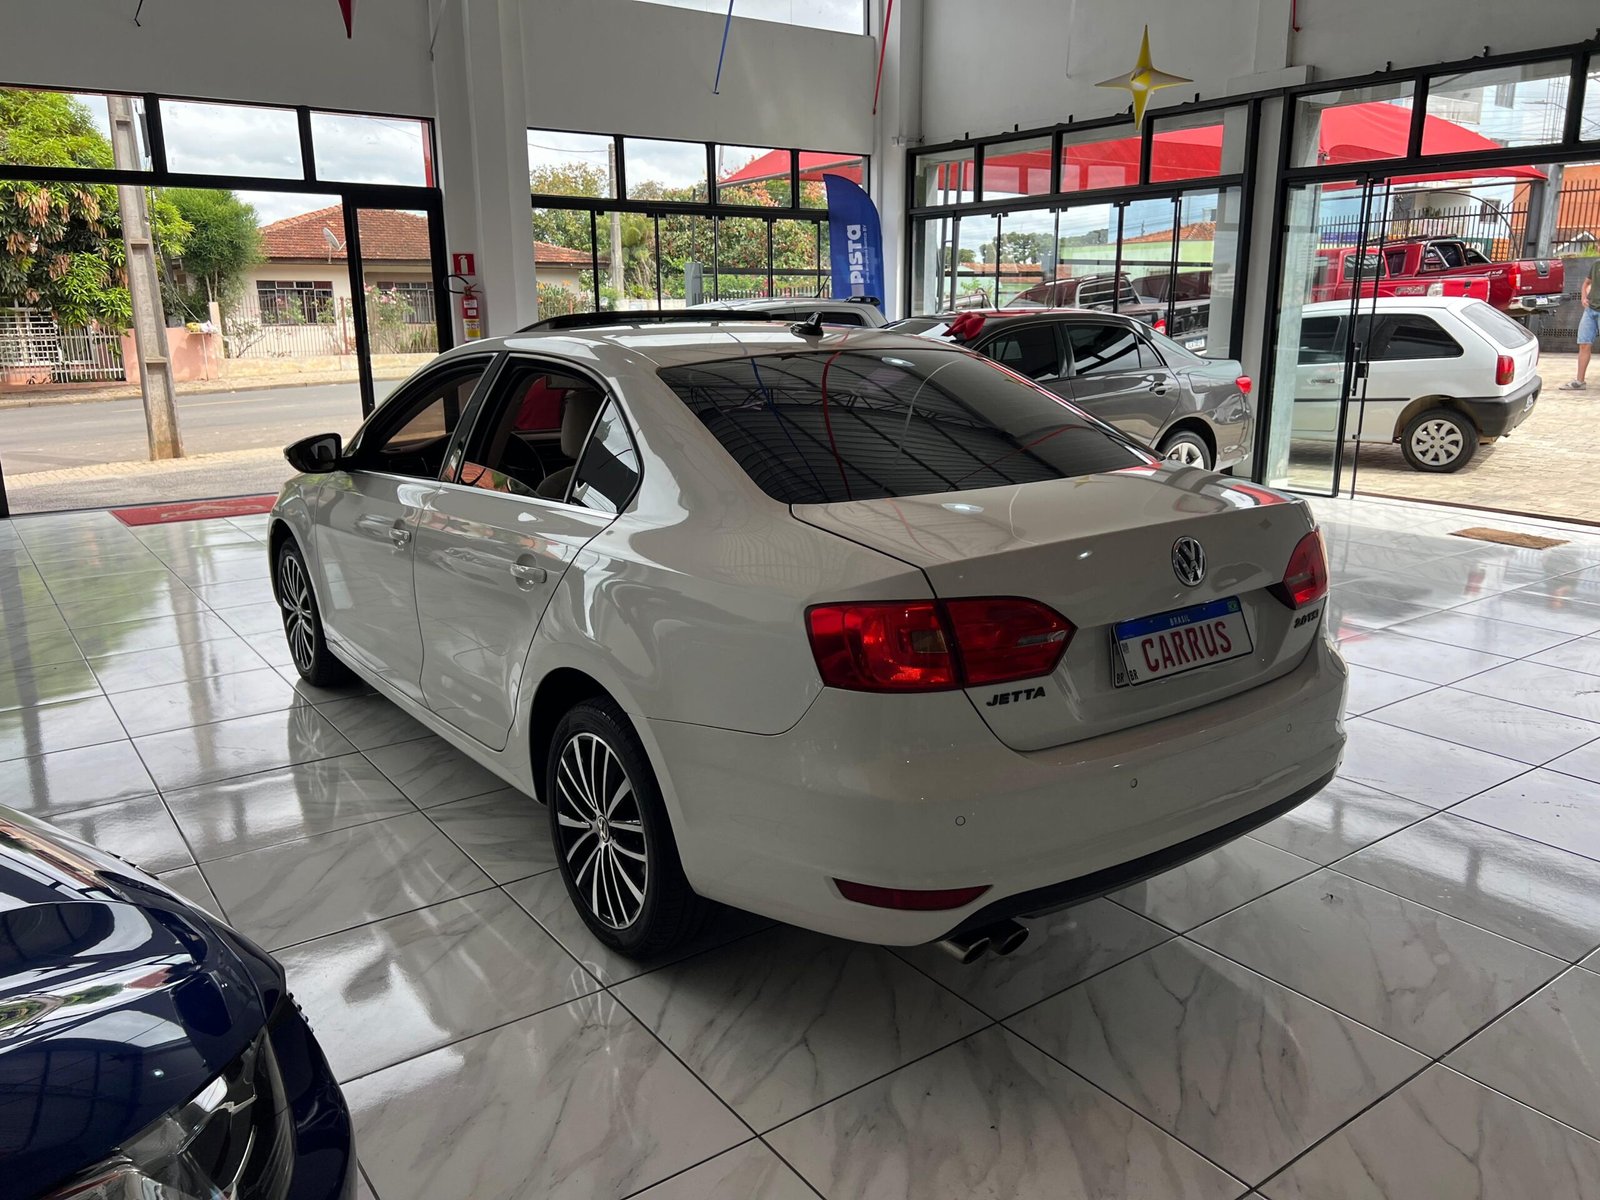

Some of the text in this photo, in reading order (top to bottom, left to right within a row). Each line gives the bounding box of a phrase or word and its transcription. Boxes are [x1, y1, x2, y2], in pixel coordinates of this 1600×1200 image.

[1169, 615, 1190, 626] BRASIL
[1141, 621, 1232, 672] CARRUS
[1129, 669, 1139, 681] BR
[986, 686, 1046, 706] JETTA
